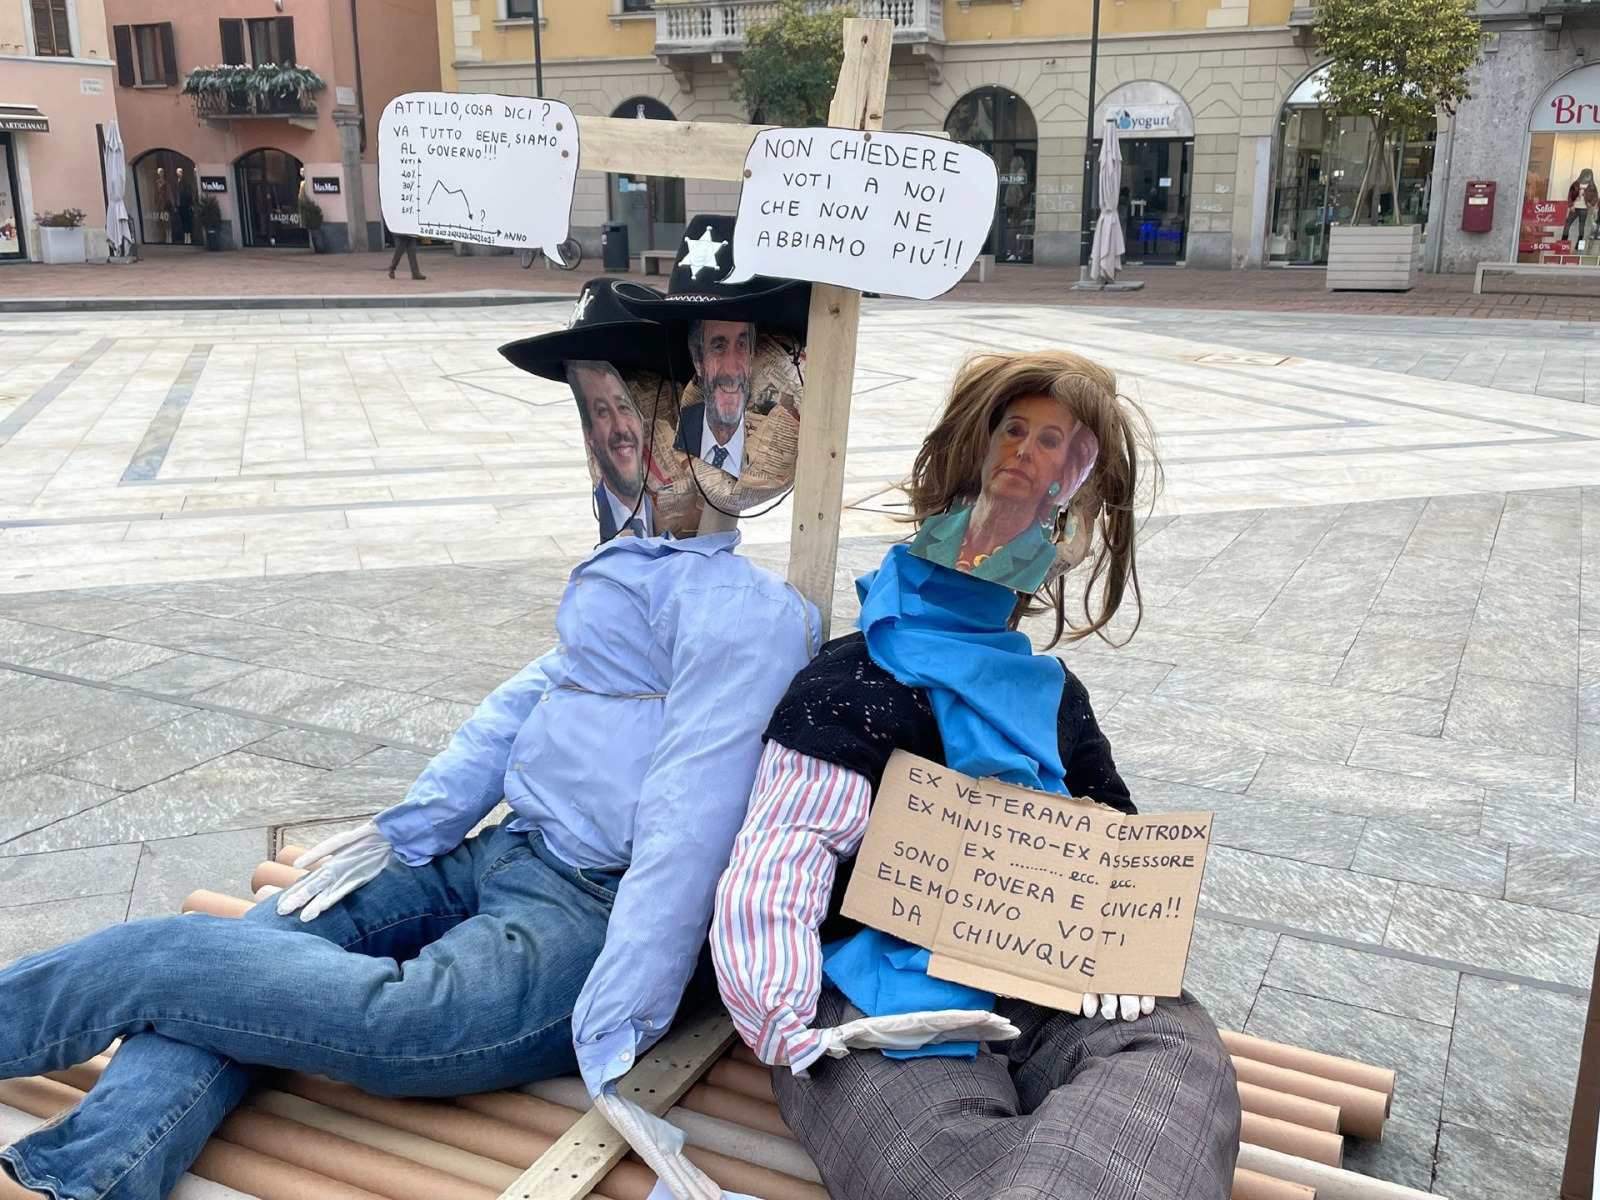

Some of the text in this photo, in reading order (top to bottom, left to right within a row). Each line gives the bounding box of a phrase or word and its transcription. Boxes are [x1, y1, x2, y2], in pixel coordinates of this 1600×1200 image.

[465, 103, 493, 117] COSA
[1132, 116, 1170, 129] yogurt
[5, 121, 48, 131] ARTIGIANALE
[393, 126, 557, 149] VA TUTTO BENE, SIAMO
[400, 157, 416, 165] VOTI
[401, 142, 497, 161] AL GOVERNO!!!
[765, 137, 961, 174] NON CHIEDERE
[783, 173, 945, 204] VOTI A NOI
[269, 213, 289, 222] SALDI
[760, 200, 932, 233] CHE NON NE
[1534, 203, 1556, 214] Saldi
[504, 232, 527, 242] ANNO
[757, 230, 865, 257] ABBIAMO
[909, 767, 1207, 841] EX VETERANA CENTRODX
[907, 793, 935, 816] EX
[1099, 851, 1195, 869] ASSESSORE
[964, 842, 996, 861] EX
[1068, 870, 1099, 886] ecc.
[1110, 879, 1136, 889] ecc.
[893, 840, 1182, 919] SONO POVERA E CIVICA!!
[877, 861, 1126, 946] ELEMOSINO VOTI
[891, 896, 1096, 978] DA CHIUNQUE
